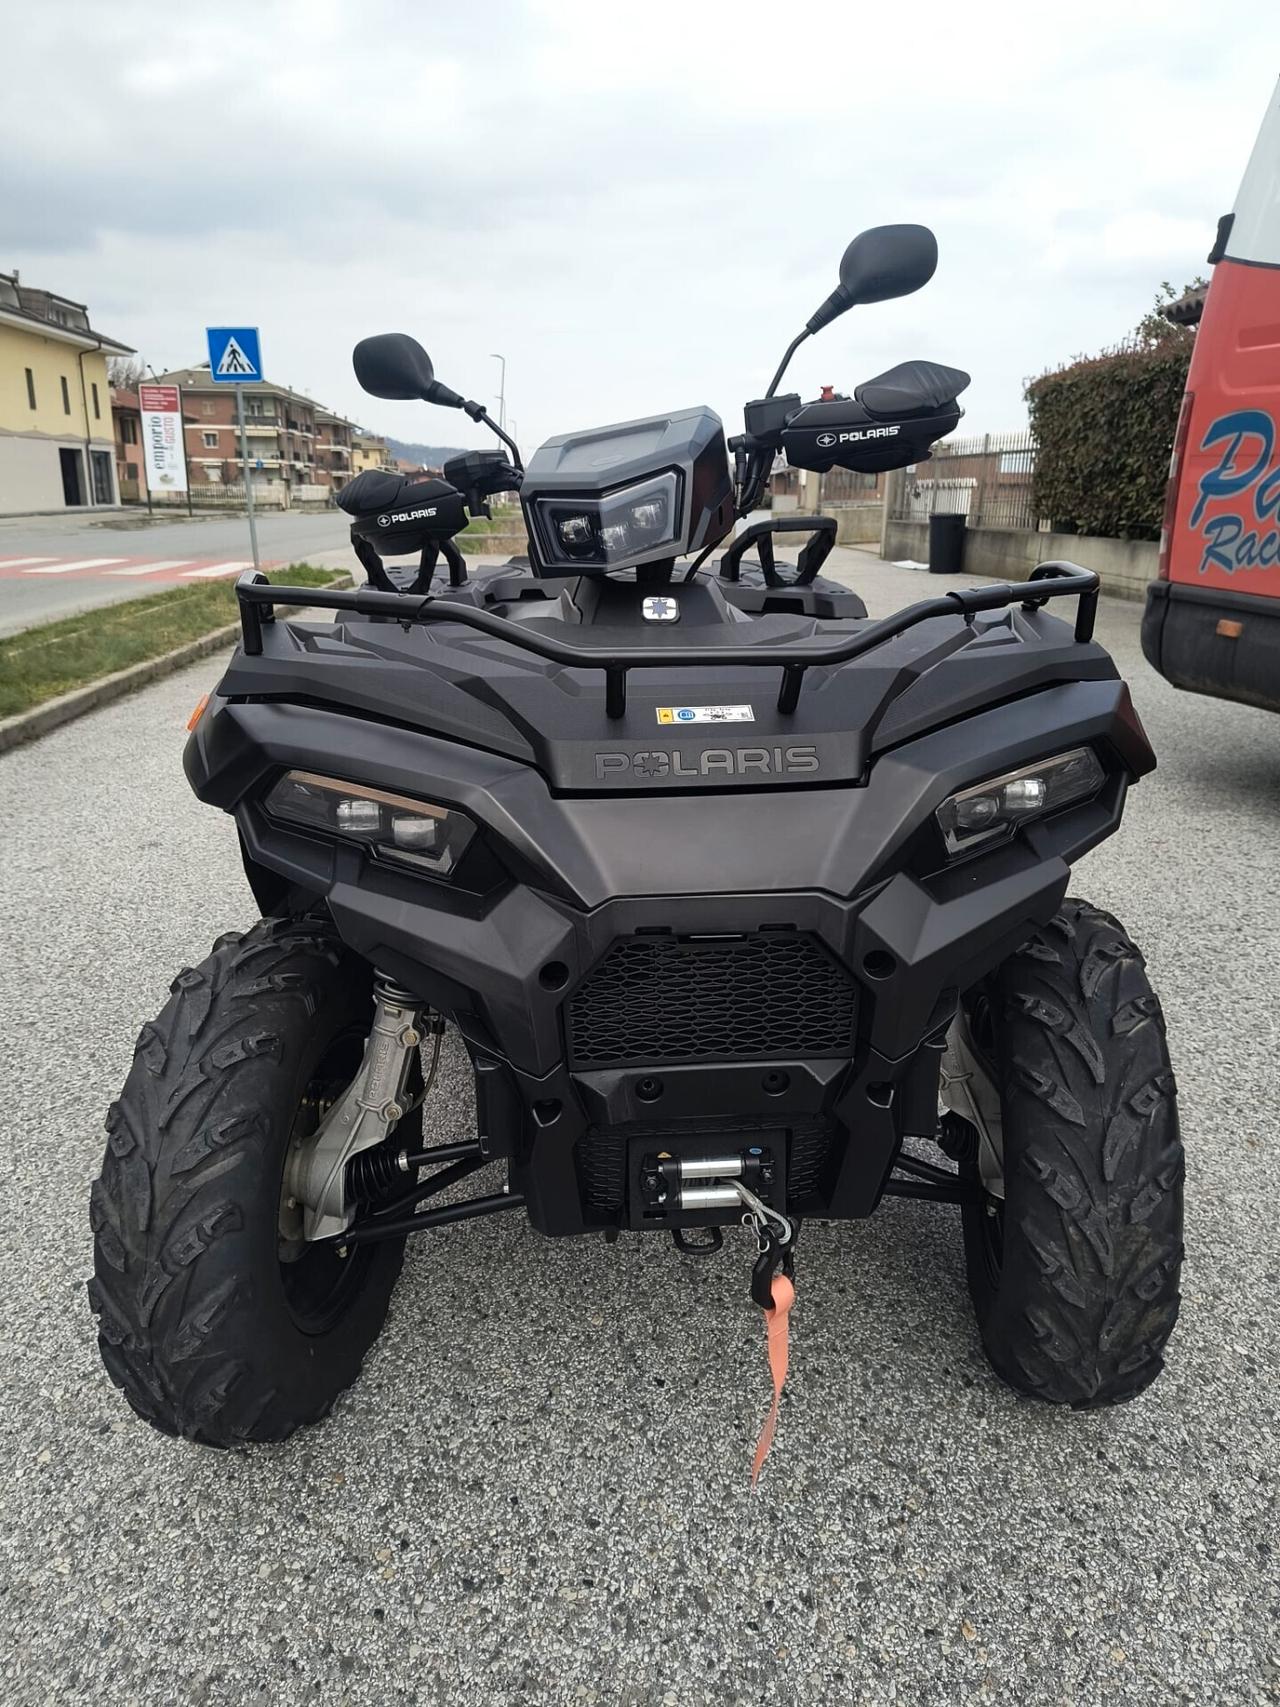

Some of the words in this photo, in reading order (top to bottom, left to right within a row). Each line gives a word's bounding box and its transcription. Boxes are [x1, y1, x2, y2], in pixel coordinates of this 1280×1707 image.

[148, 416, 168, 470] emporio
[839, 425, 900, 443] POLARIS
[391, 507, 437, 523] POLARIS
[1200, 515, 1280, 573] Rac
[595, 745, 820, 780] POLARIS
